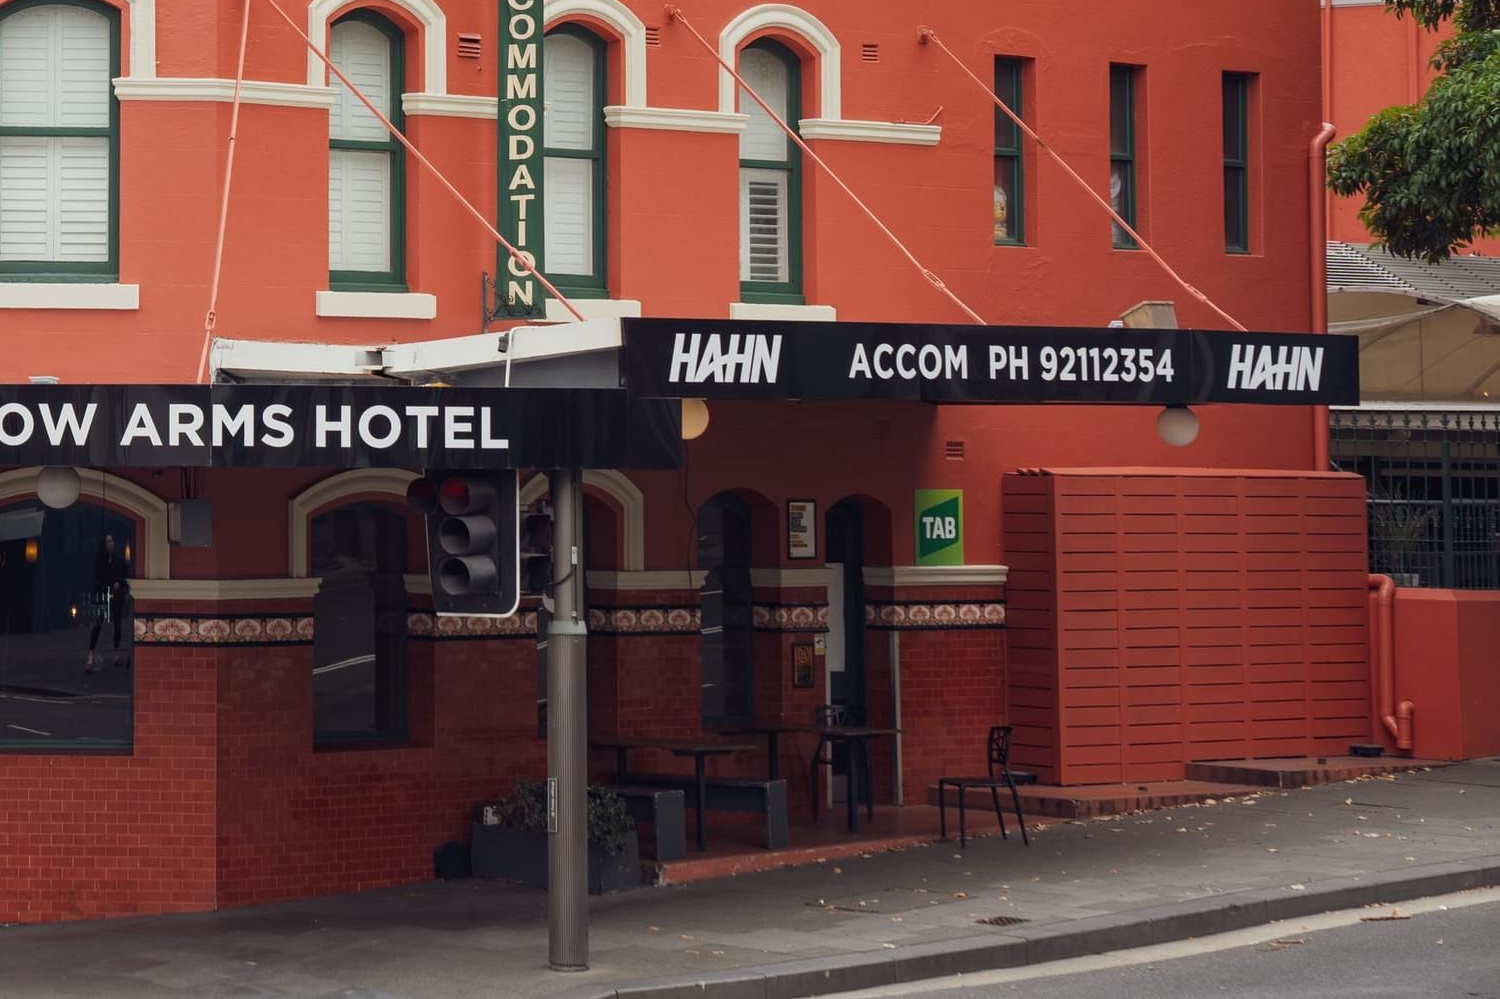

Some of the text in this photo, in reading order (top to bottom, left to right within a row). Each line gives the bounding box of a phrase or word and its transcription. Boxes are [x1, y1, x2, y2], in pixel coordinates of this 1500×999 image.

[667, 333, 783, 384] HAHN
[848, 343, 1175, 383] ACCOM PH 92112354
[1226, 343, 1325, 392] HAHN
[119, 403, 295, 448] ARMS
[314, 404, 510, 450] HOTEL
[922, 516, 956, 539] TAB
